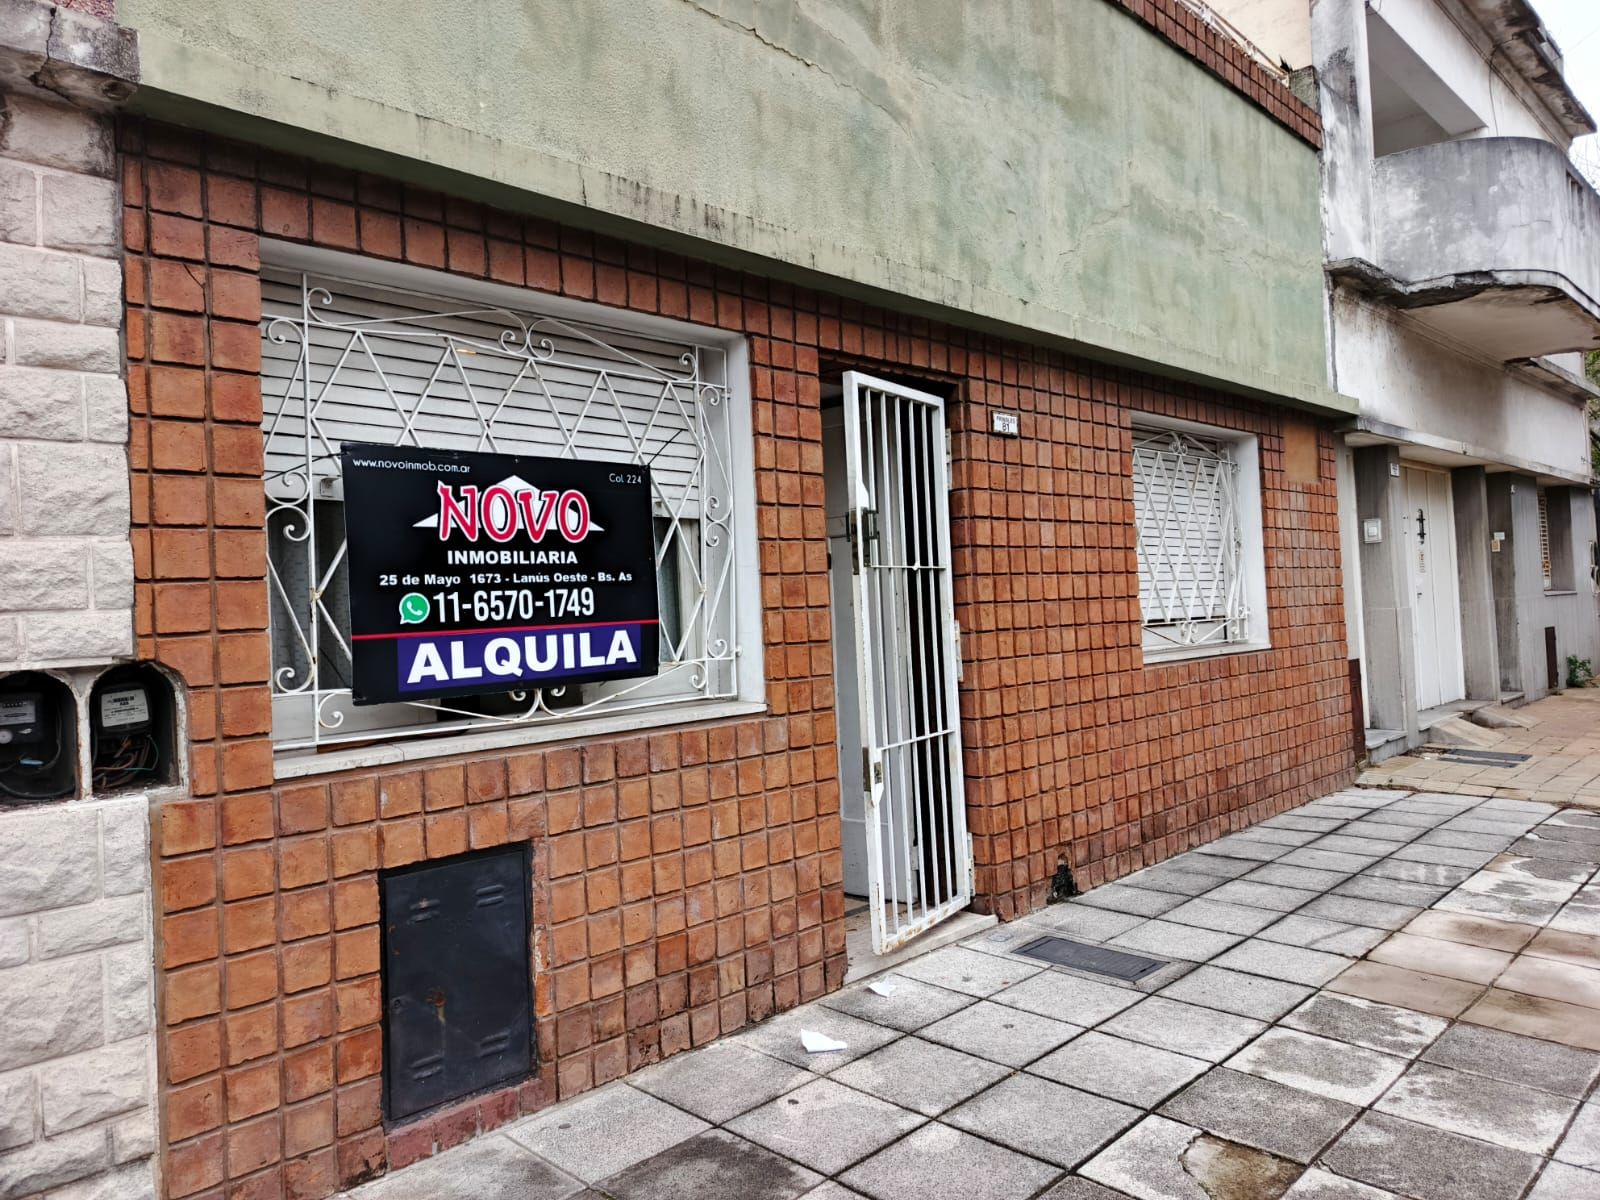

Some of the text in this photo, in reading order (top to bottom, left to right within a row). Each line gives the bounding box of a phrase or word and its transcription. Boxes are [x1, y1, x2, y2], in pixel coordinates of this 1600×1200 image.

[352, 459, 471, 473] www.novoinmob.com.ar
[626, 474, 642, 484] 224
[437, 480, 591, 543] NOVO
[447, 550, 578, 565] INMOBILIARIA
[379, 574, 398, 586] 25
[402, 574, 420, 585] de
[424, 574, 461, 587] Mayo
[469, 573, 502, 584] 1673
[513, 572, 550, 583] Lanús
[553, 572, 588, 582] Oeste
[597, 572, 616, 582] Bs.
[618, 571, 633, 581] As
[433, 587, 595, 623] 11-6570-1749
[407, 630, 637, 684] ALQUILA
